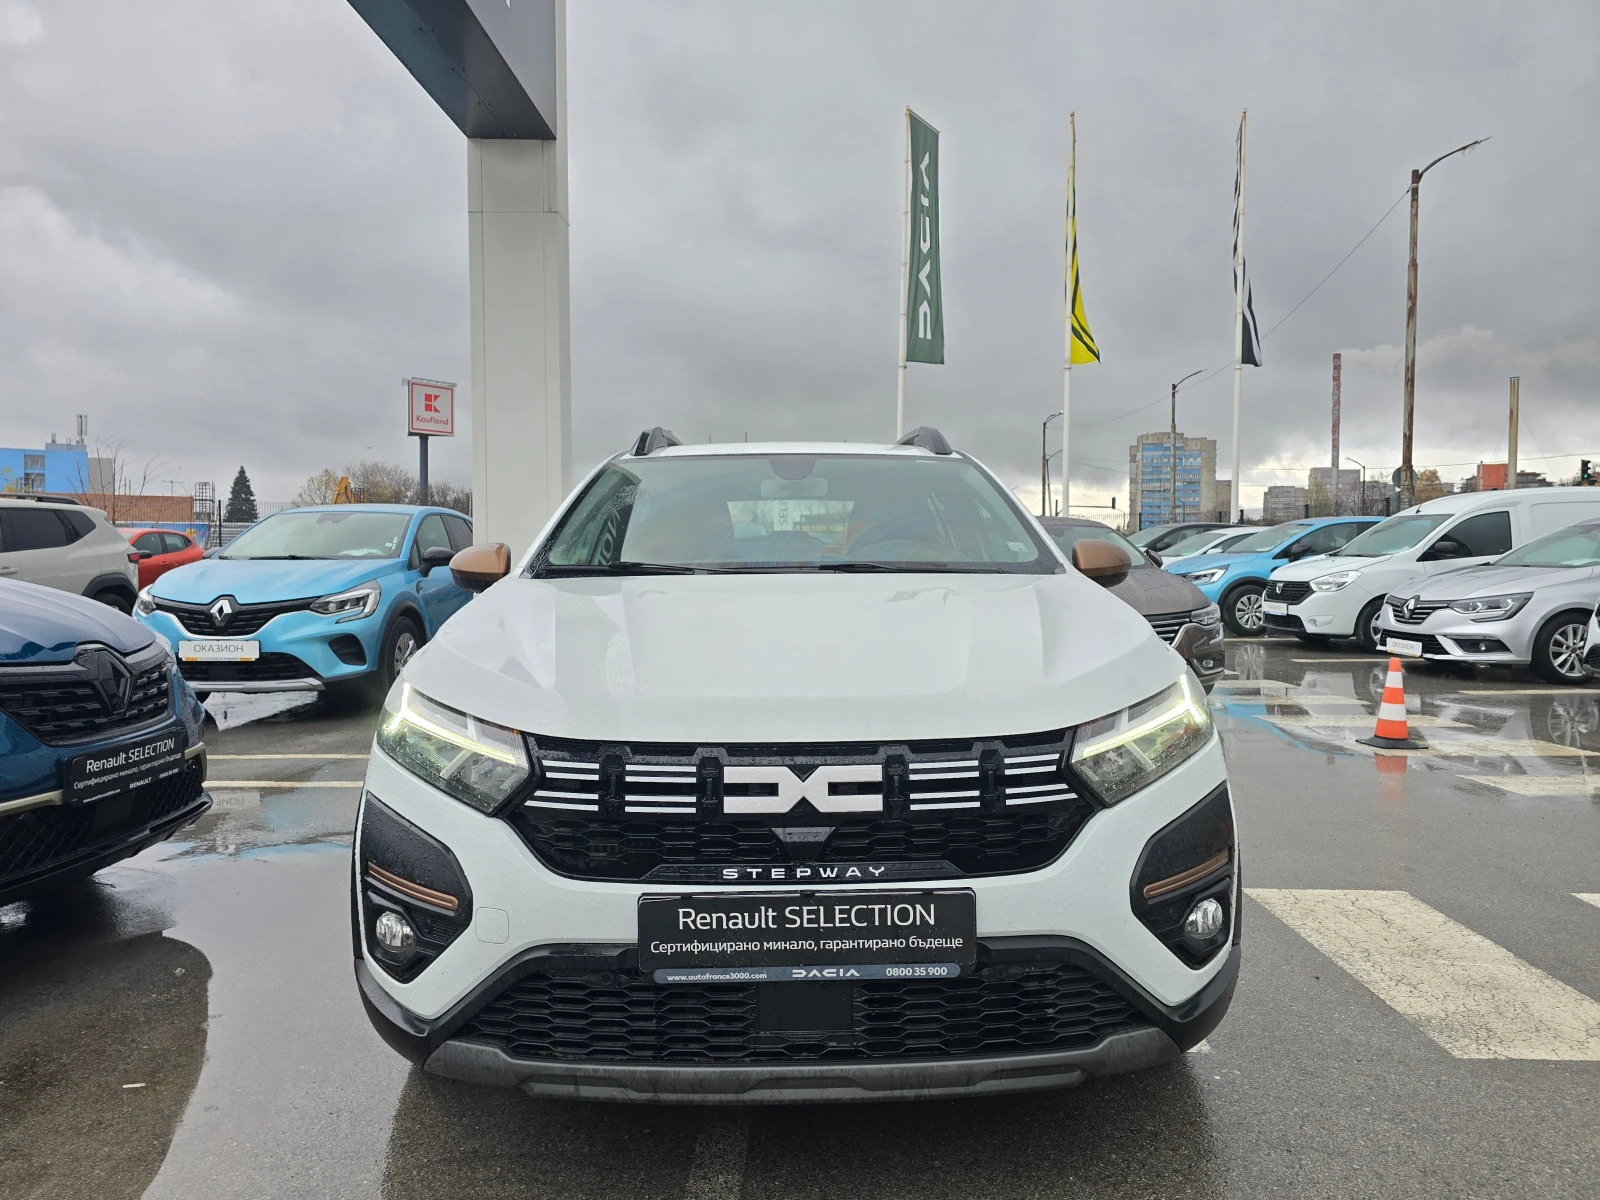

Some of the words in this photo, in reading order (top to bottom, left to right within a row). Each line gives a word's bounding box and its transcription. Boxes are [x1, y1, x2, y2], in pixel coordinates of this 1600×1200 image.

[918, 151, 932, 340] DACIA
[416, 415, 449, 425] Kaufland
[193, 644, 244, 653] ОКАЗИОН
[86, 751, 127, 774] Renault
[127, 737, 175, 763] SELECTION
[129, 776, 152, 789] RENAULT
[722, 866, 885, 879] STEPWAY
[677, 906, 778, 930] Renault
[784, 903, 936, 929] SELECTION
[650, 939, 761, 956] Сертифицирано
[763, 939, 818, 951] минало,
[820, 937, 906, 951] гарантирано
[908, 935, 964, 950] бъдеще
[666, 972, 768, 981] www.autofrance3000.com
[792, 968, 861, 978] DACIA
[885, 967, 913, 977] 0800
[914, 967, 927, 976] 35
[927, 966, 948, 976] 900
